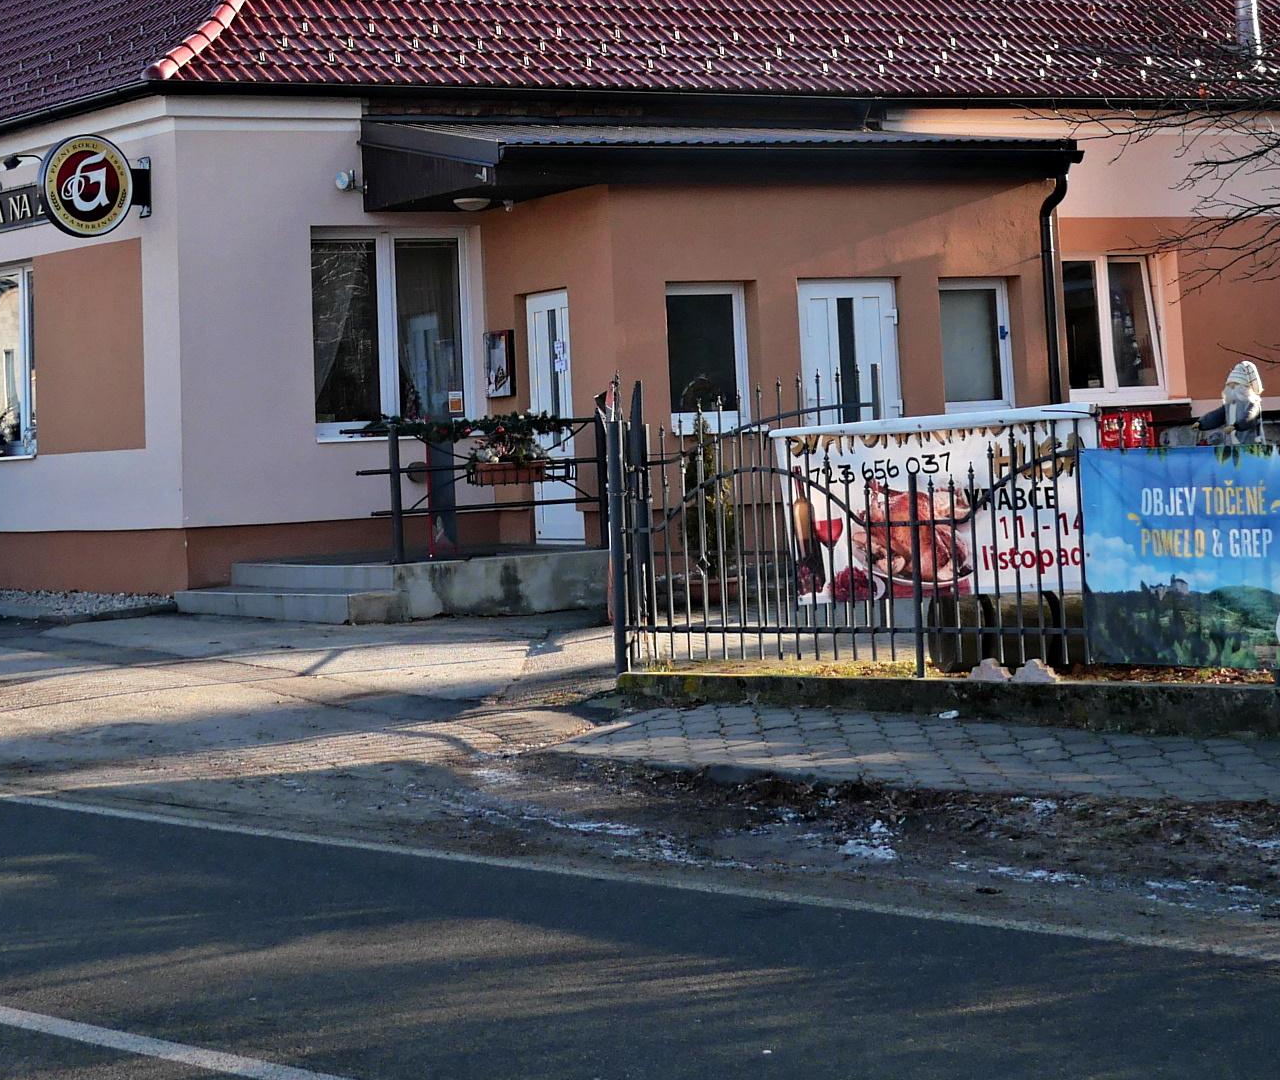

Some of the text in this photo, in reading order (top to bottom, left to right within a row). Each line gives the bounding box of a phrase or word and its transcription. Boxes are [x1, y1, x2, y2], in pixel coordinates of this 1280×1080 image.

[9, 193, 32, 221] NA
[62, 213, 118, 229] GAMBRINUS
[861, 458, 900, 482] 656
[905, 451, 951, 475] 037
[1141, 479, 1268, 517] OBJEV TOČENÉ
[1140, 528, 1273, 558] POMELO & GREP
